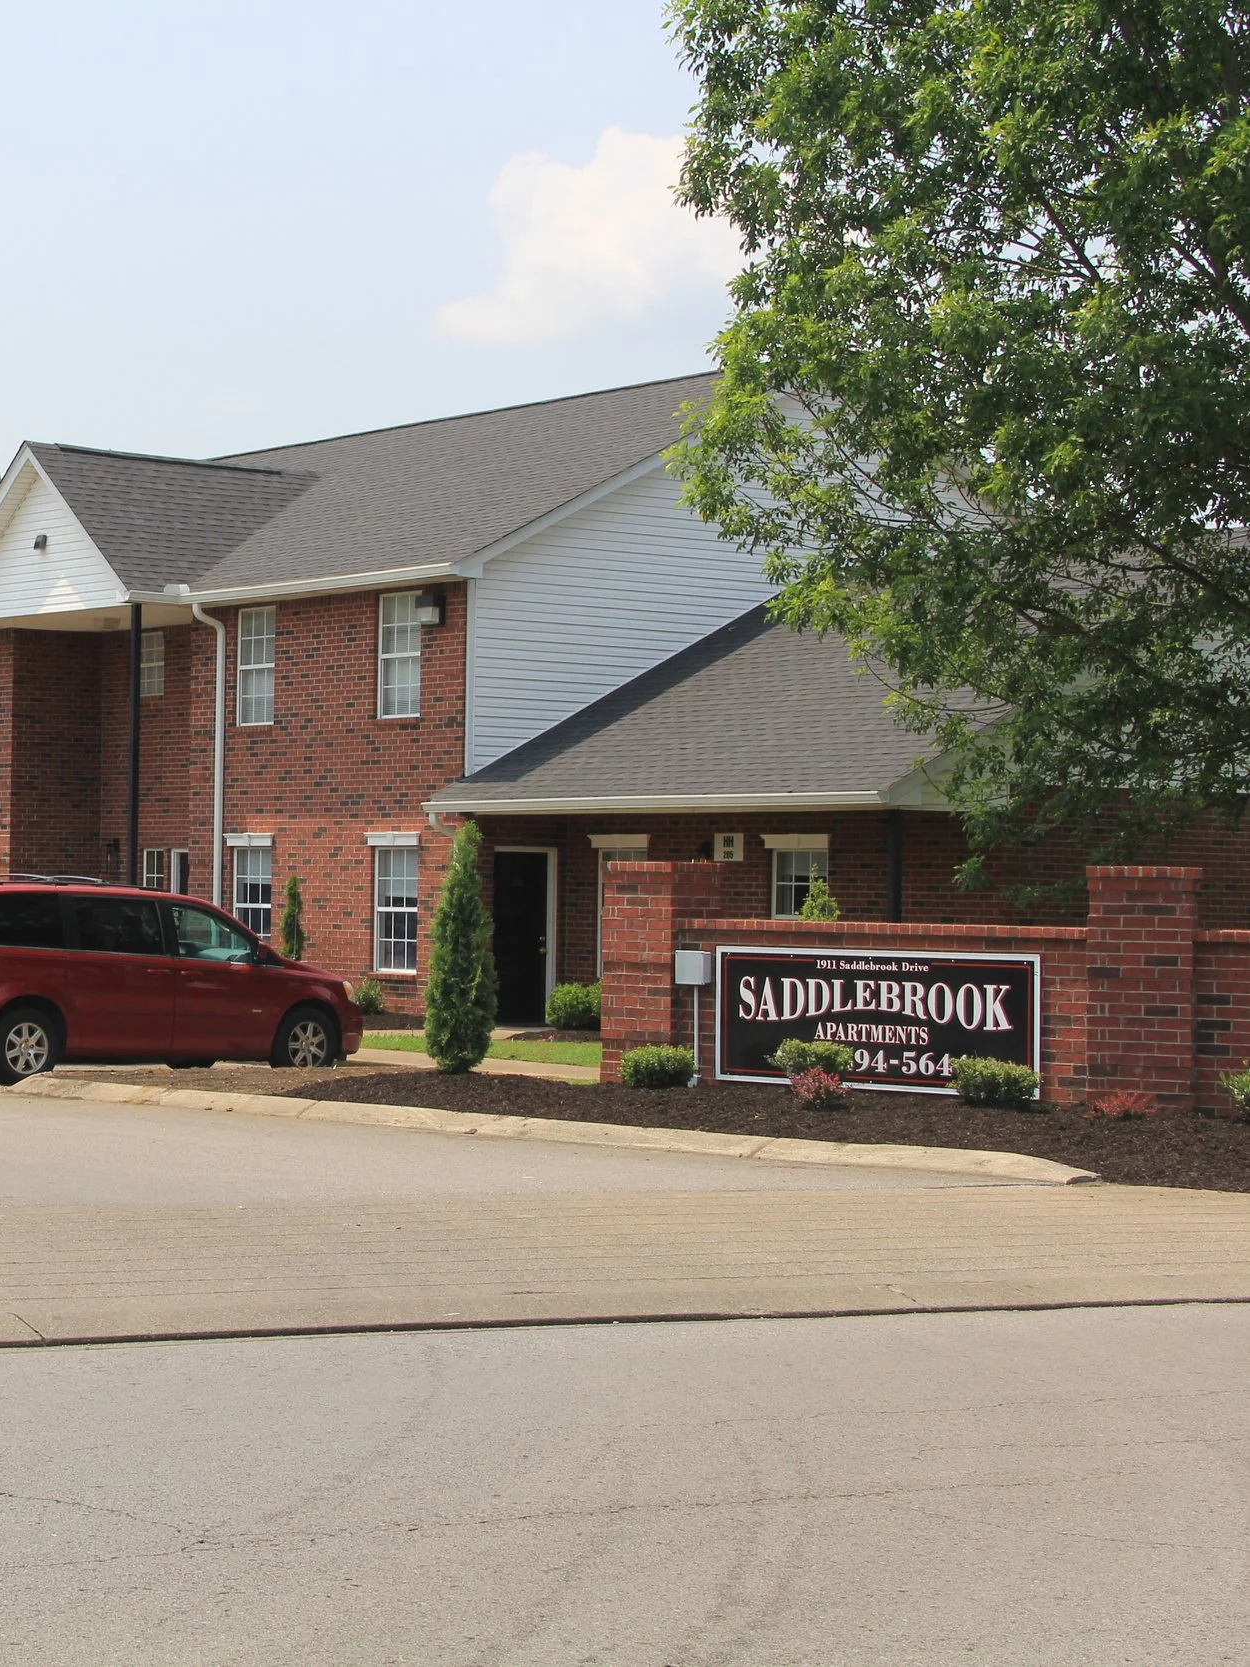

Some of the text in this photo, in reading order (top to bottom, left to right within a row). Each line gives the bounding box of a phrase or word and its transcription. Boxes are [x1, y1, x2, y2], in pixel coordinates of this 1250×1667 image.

[816, 959, 929, 972] 1911 Saddlebrook Drive
[739, 975, 1013, 1031] SADDLEBROOK
[814, 1022, 930, 1046] APARTMENTS
[849, 1048, 967, 1077] 94-564
